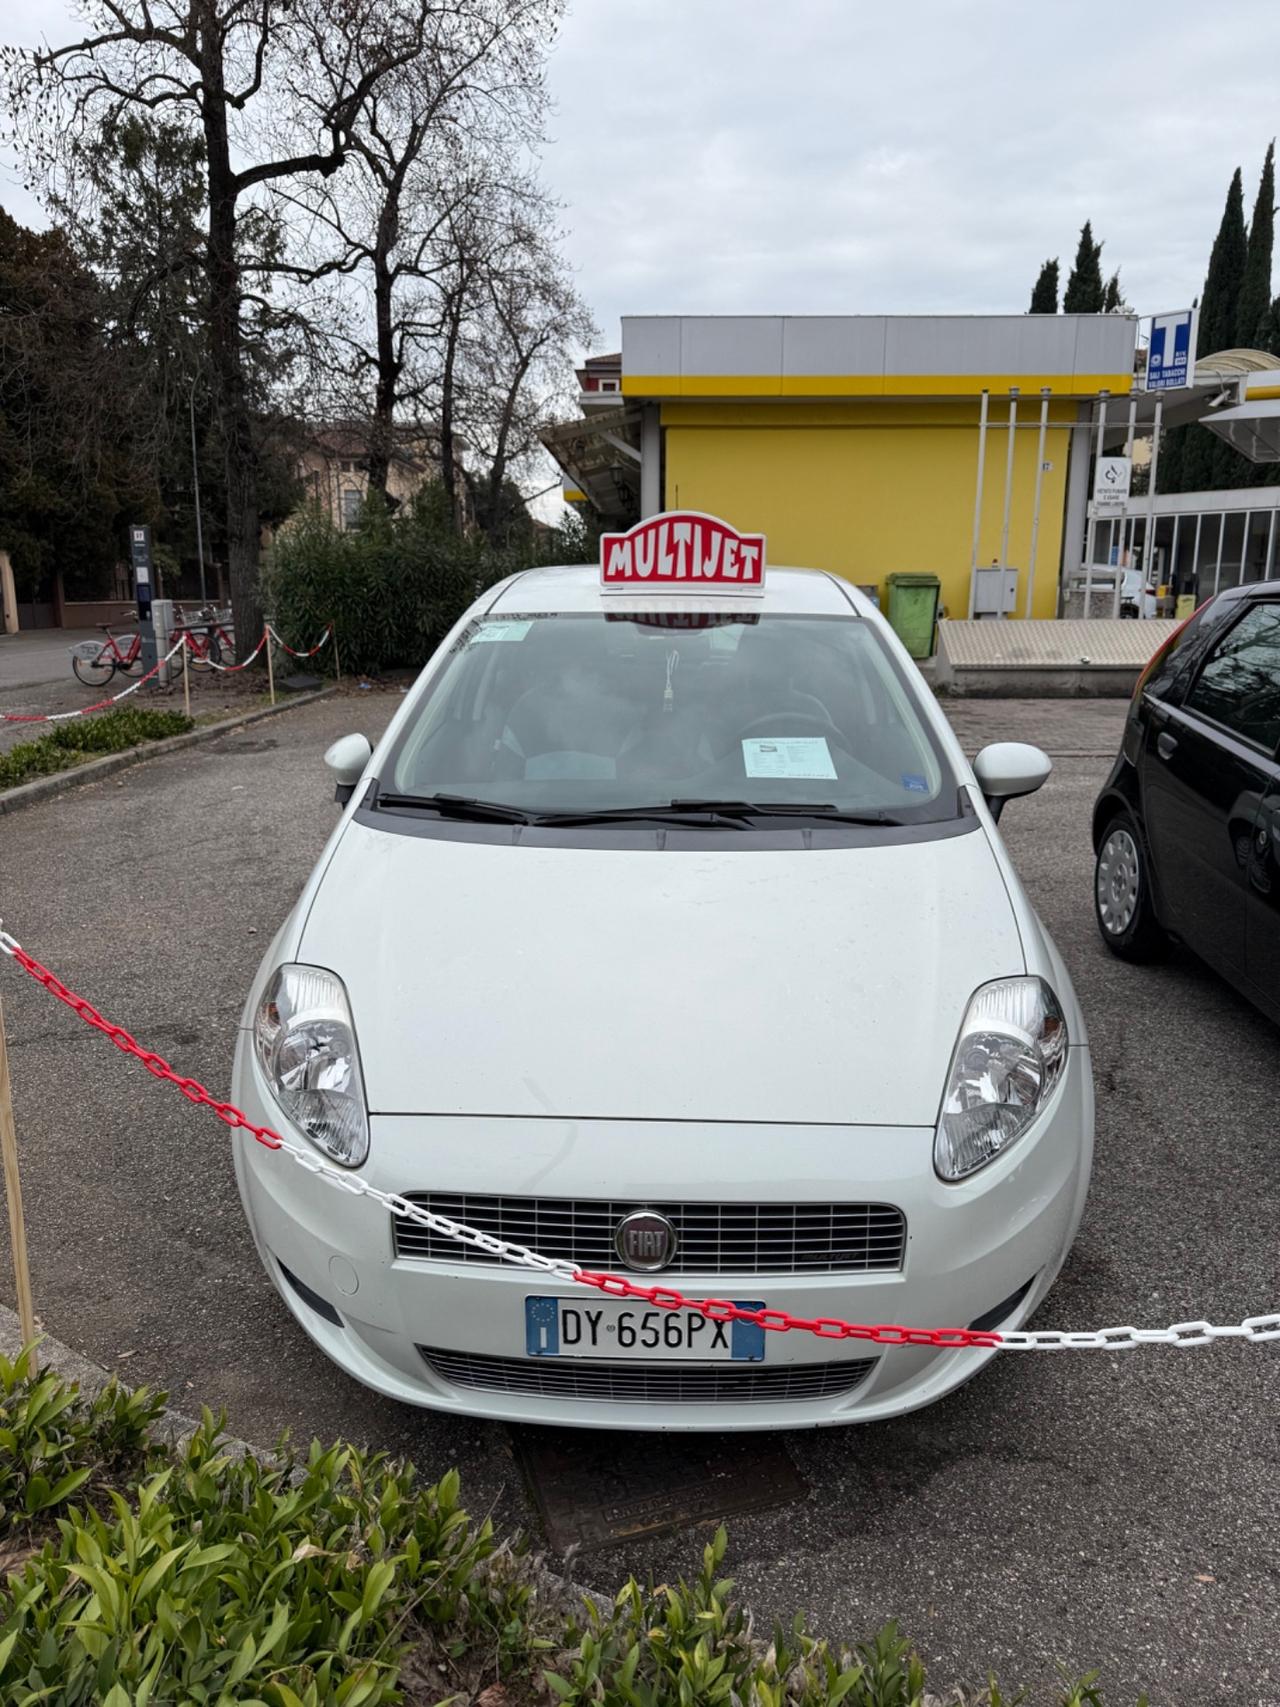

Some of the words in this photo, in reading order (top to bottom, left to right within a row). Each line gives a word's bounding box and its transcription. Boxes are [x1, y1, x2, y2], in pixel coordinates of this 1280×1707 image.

[1155, 312, 1189, 368] T
[607, 522, 759, 579] MULTIJET
[629, 1230, 665, 1257] FIAT
[561, 1309, 604, 1346] DY
[617, 1312, 729, 1349] 656PX
